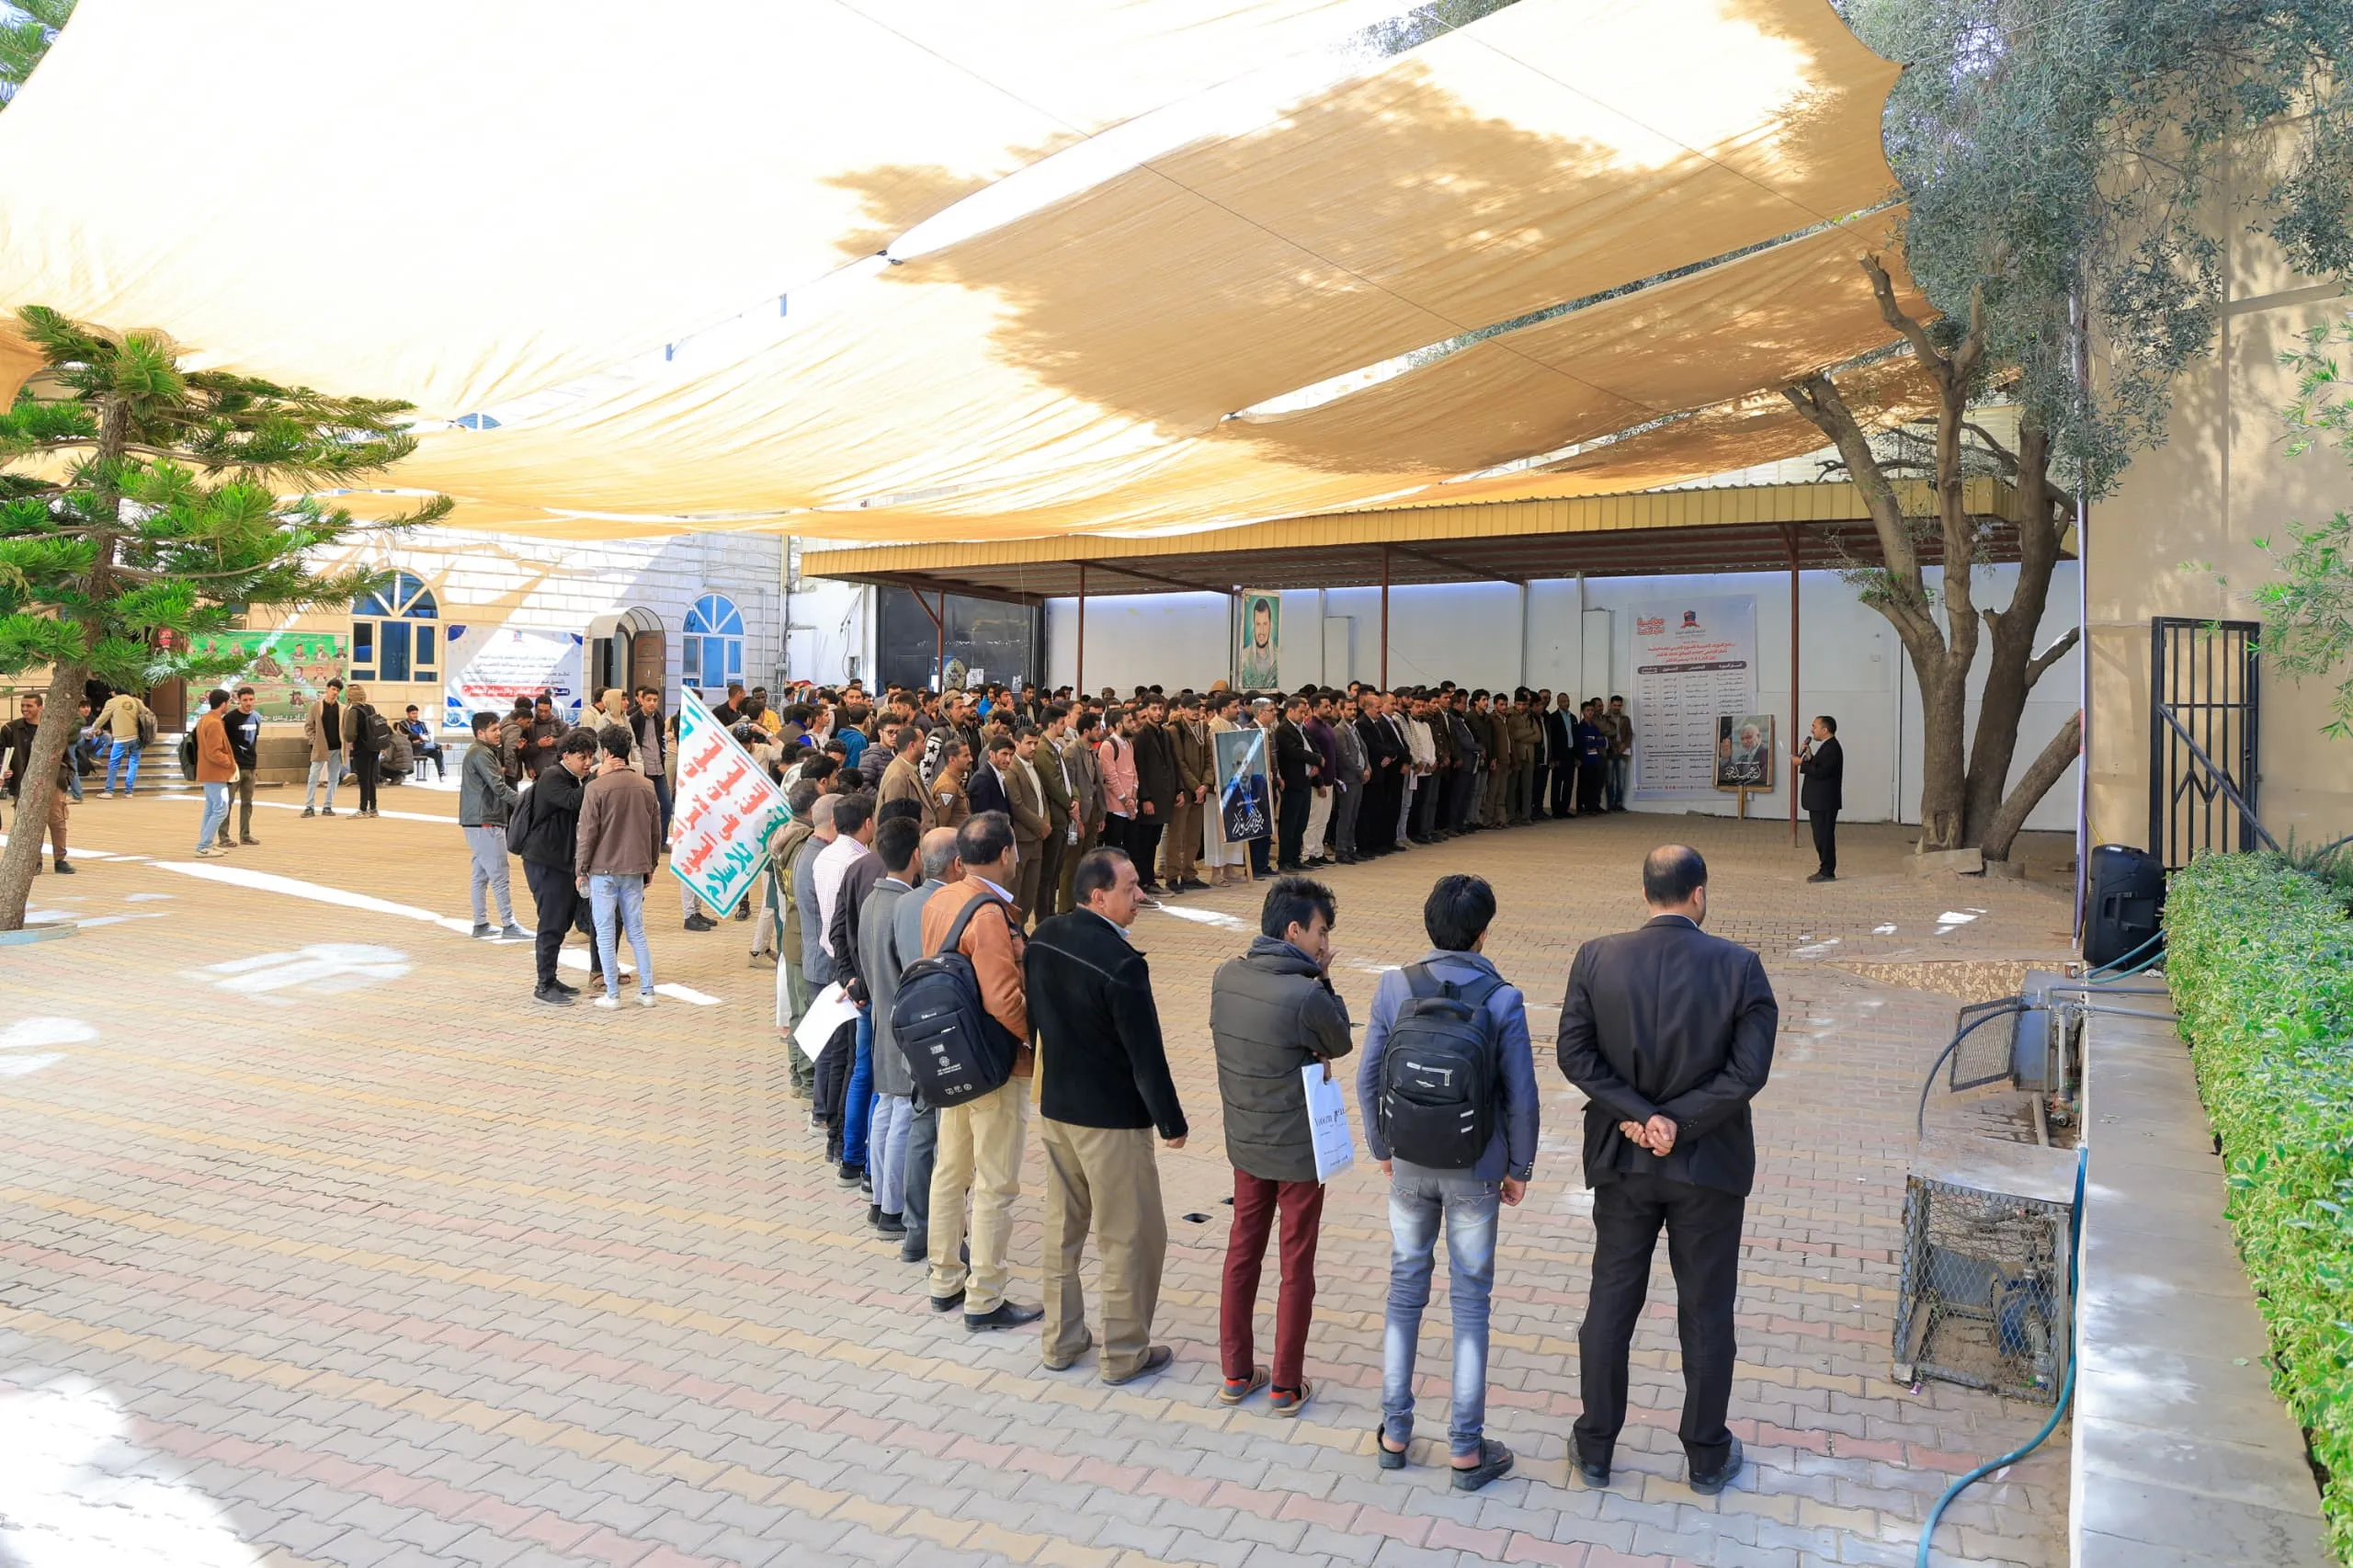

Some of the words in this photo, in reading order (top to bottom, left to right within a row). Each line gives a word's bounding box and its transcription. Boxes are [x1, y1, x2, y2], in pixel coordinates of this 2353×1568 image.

[683, 730, 727, 779] الموت
[706, 754, 751, 801] الموت
[734, 778, 773, 815] اللعنة
[718, 813, 741, 842] على
[679, 830, 718, 876] اليهود
[704, 840, 755, 905] للإسلام
